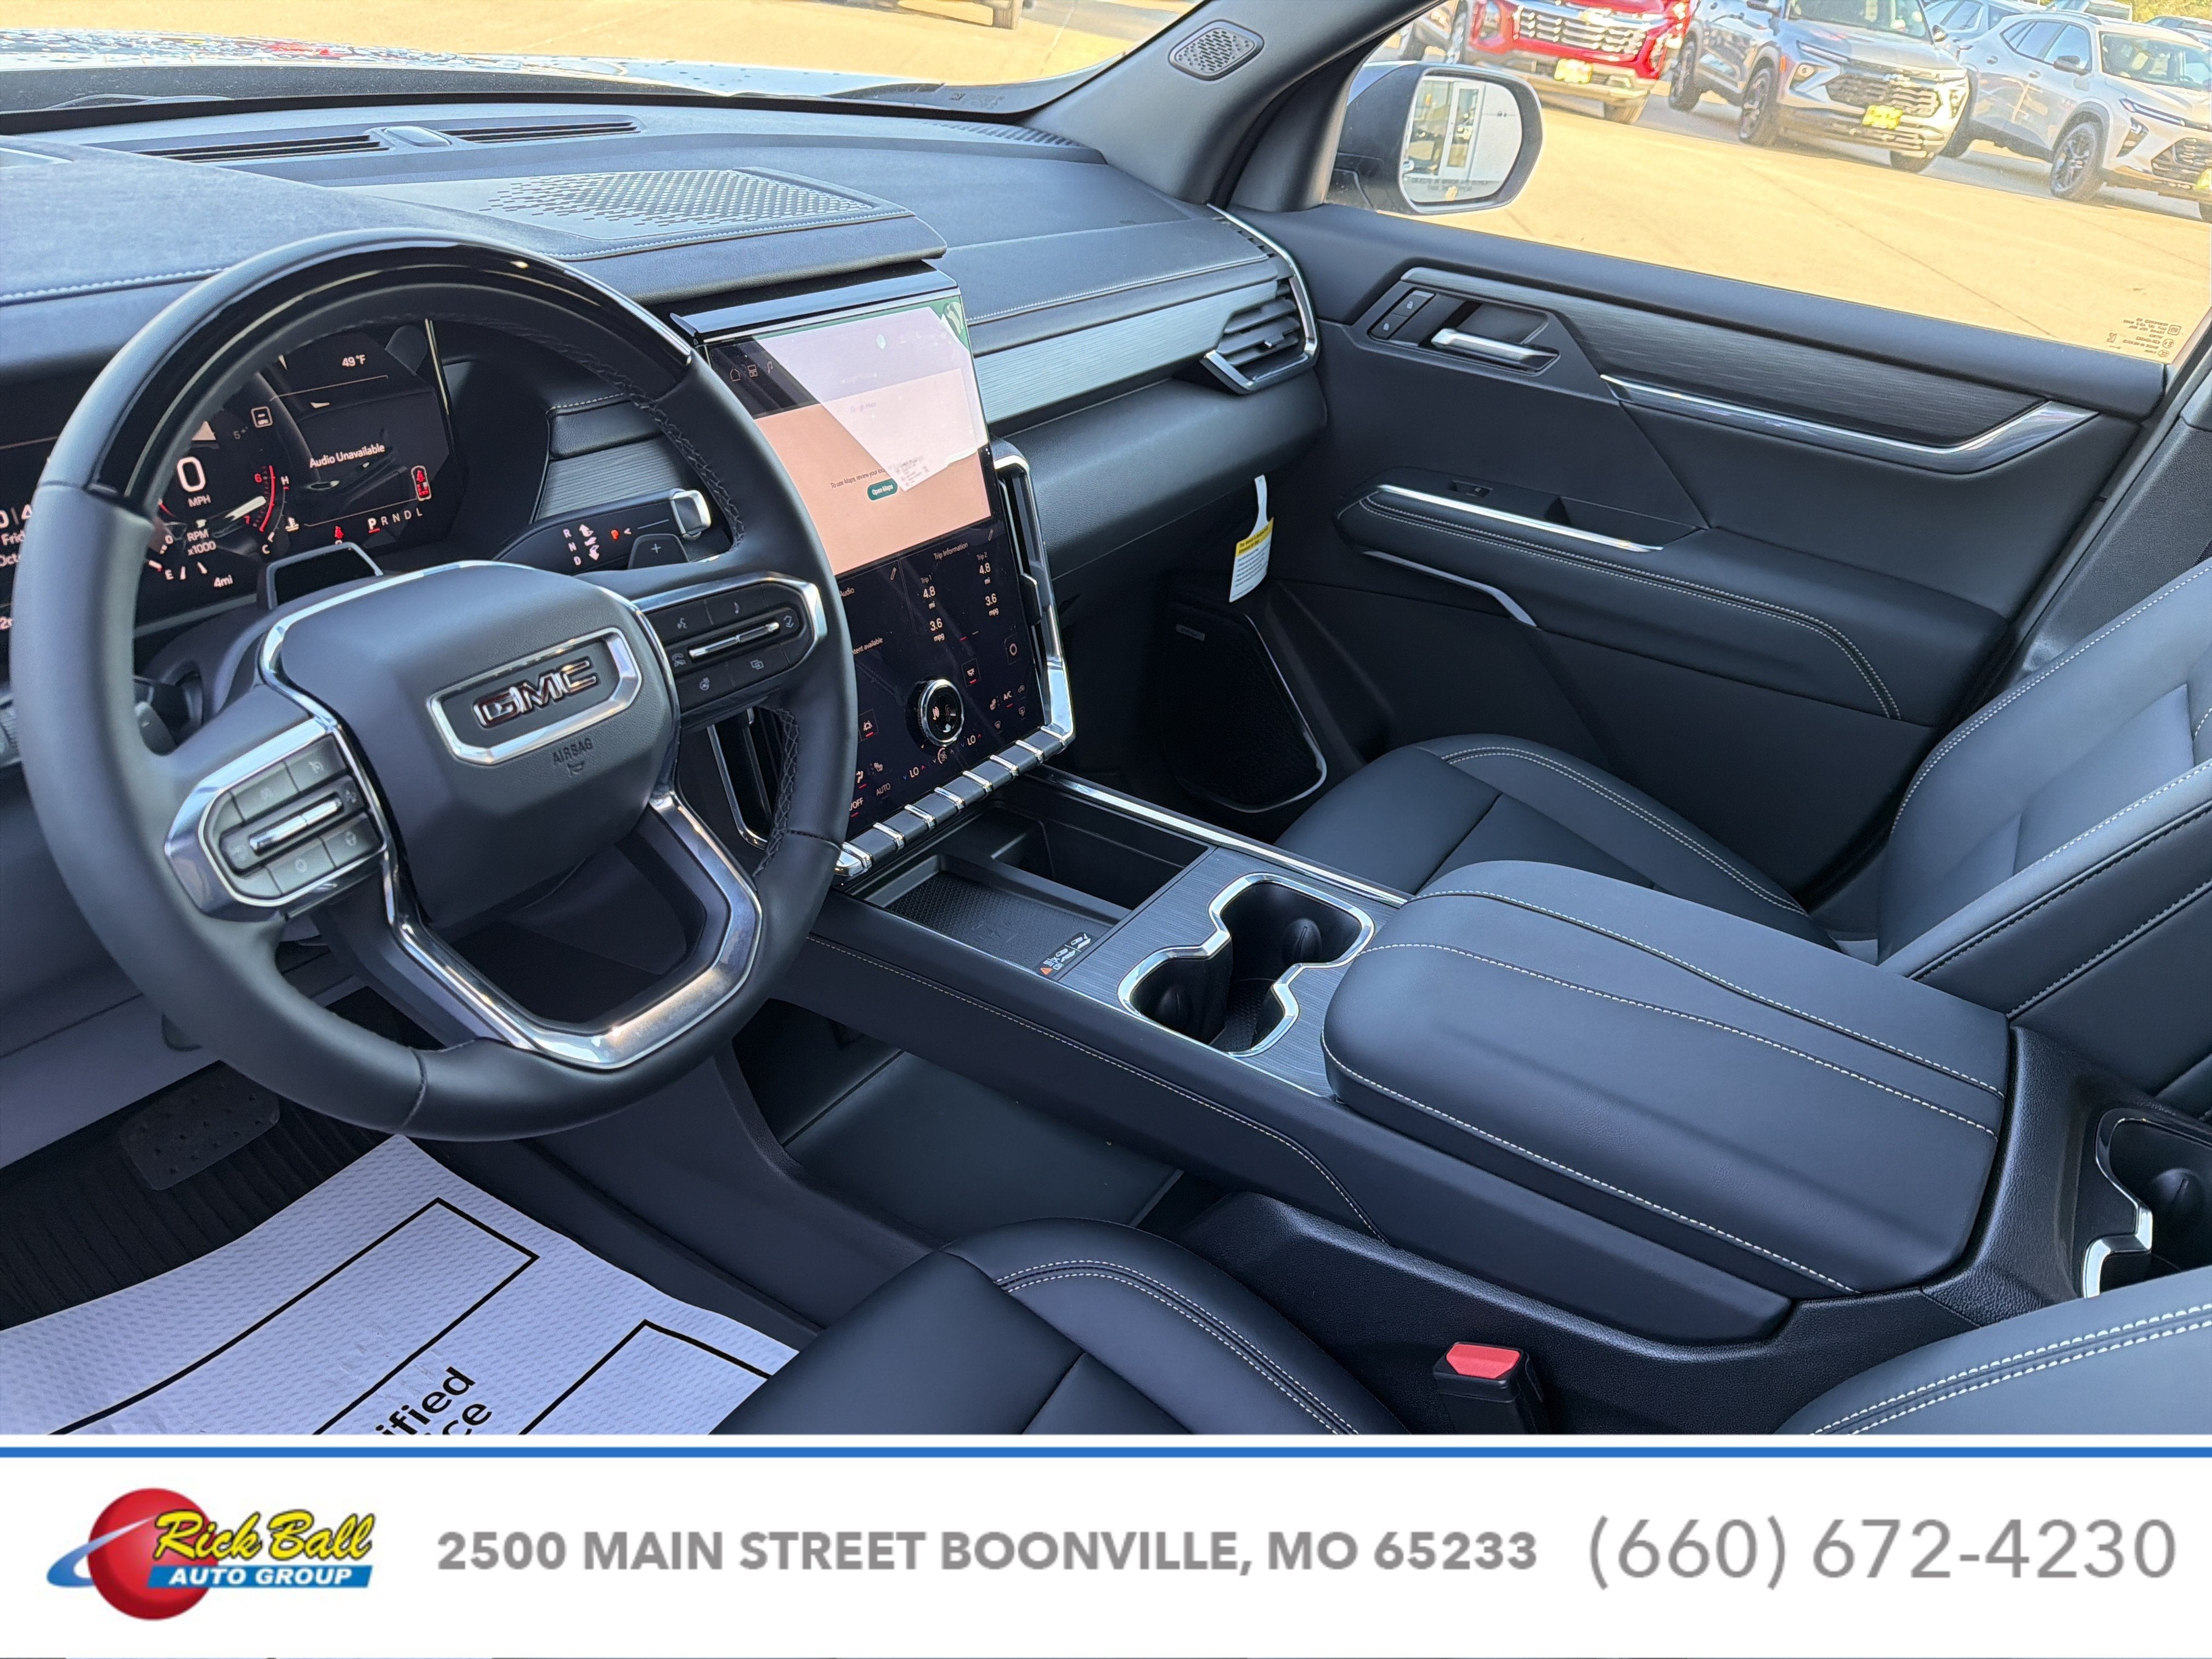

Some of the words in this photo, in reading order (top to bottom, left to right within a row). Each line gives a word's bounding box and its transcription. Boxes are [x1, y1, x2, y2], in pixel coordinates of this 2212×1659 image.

[342, 354, 366, 367] 49°F
[309, 454, 335, 468] Audio
[336, 443, 385, 462] Unavailable
[177, 456, 206, 492] 0
[254, 473, 262, 483] 6
[280, 476, 290, 485] H
[188, 494, 211, 507] MPH
[368, 517, 376, 530] P
[381, 516, 388, 526] R
[392, 512, 400, 523] N
[404, 510, 412, 520] D
[416, 507, 423, 517] L
[187, 529, 209, 542] RPM
[563, 528, 572, 538] R
[187, 541, 217, 556] x1000
[262, 544, 270, 554] C
[568, 541, 577, 551] N
[933, 552, 943, 561] Trip
[943, 542, 968, 557] Information
[165, 569, 174, 580] E
[979, 562, 991, 574] 4.8
[213, 574, 234, 588] 4mi
[923, 585, 936, 599] 4.8
[929, 601, 936, 610] mi
[985, 593, 997, 606] 3.6
[989, 607, 1000, 617] mpg
[929, 618, 943, 631] 3.6
[864, 637, 883, 651] available
[934, 633, 945, 642] mpg
[473, 660, 598, 727] GMC
[967, 735, 976, 746] LO
[552, 738, 593, 765] AIRBAG
[910, 766, 919, 778] LO
[876, 782, 891, 796] AUTO
